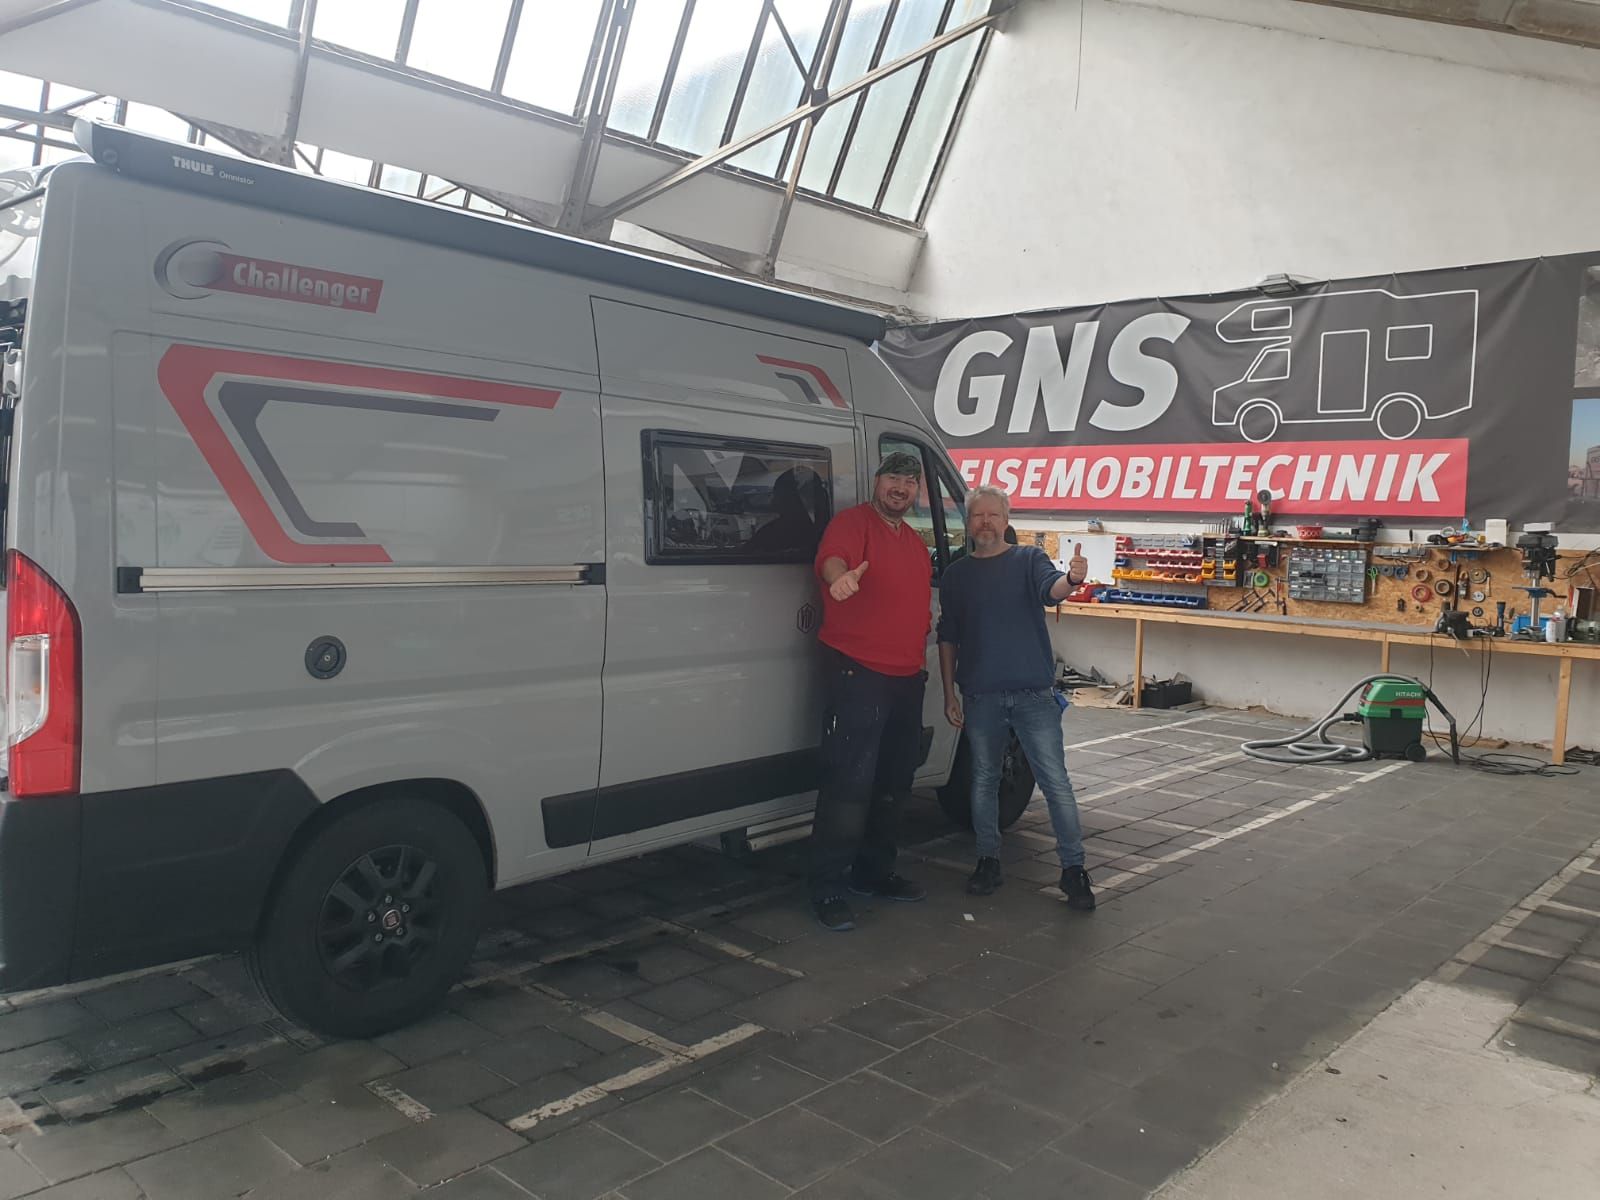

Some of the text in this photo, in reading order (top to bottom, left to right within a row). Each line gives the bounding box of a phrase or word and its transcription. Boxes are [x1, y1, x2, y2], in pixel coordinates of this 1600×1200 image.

[172, 157, 255, 185] THULE Omnistor
[229, 262, 370, 306] Challenger
[934, 312, 1191, 437] GNS
[944, 453, 1450, 503] EISEMOBILTECHNIK
